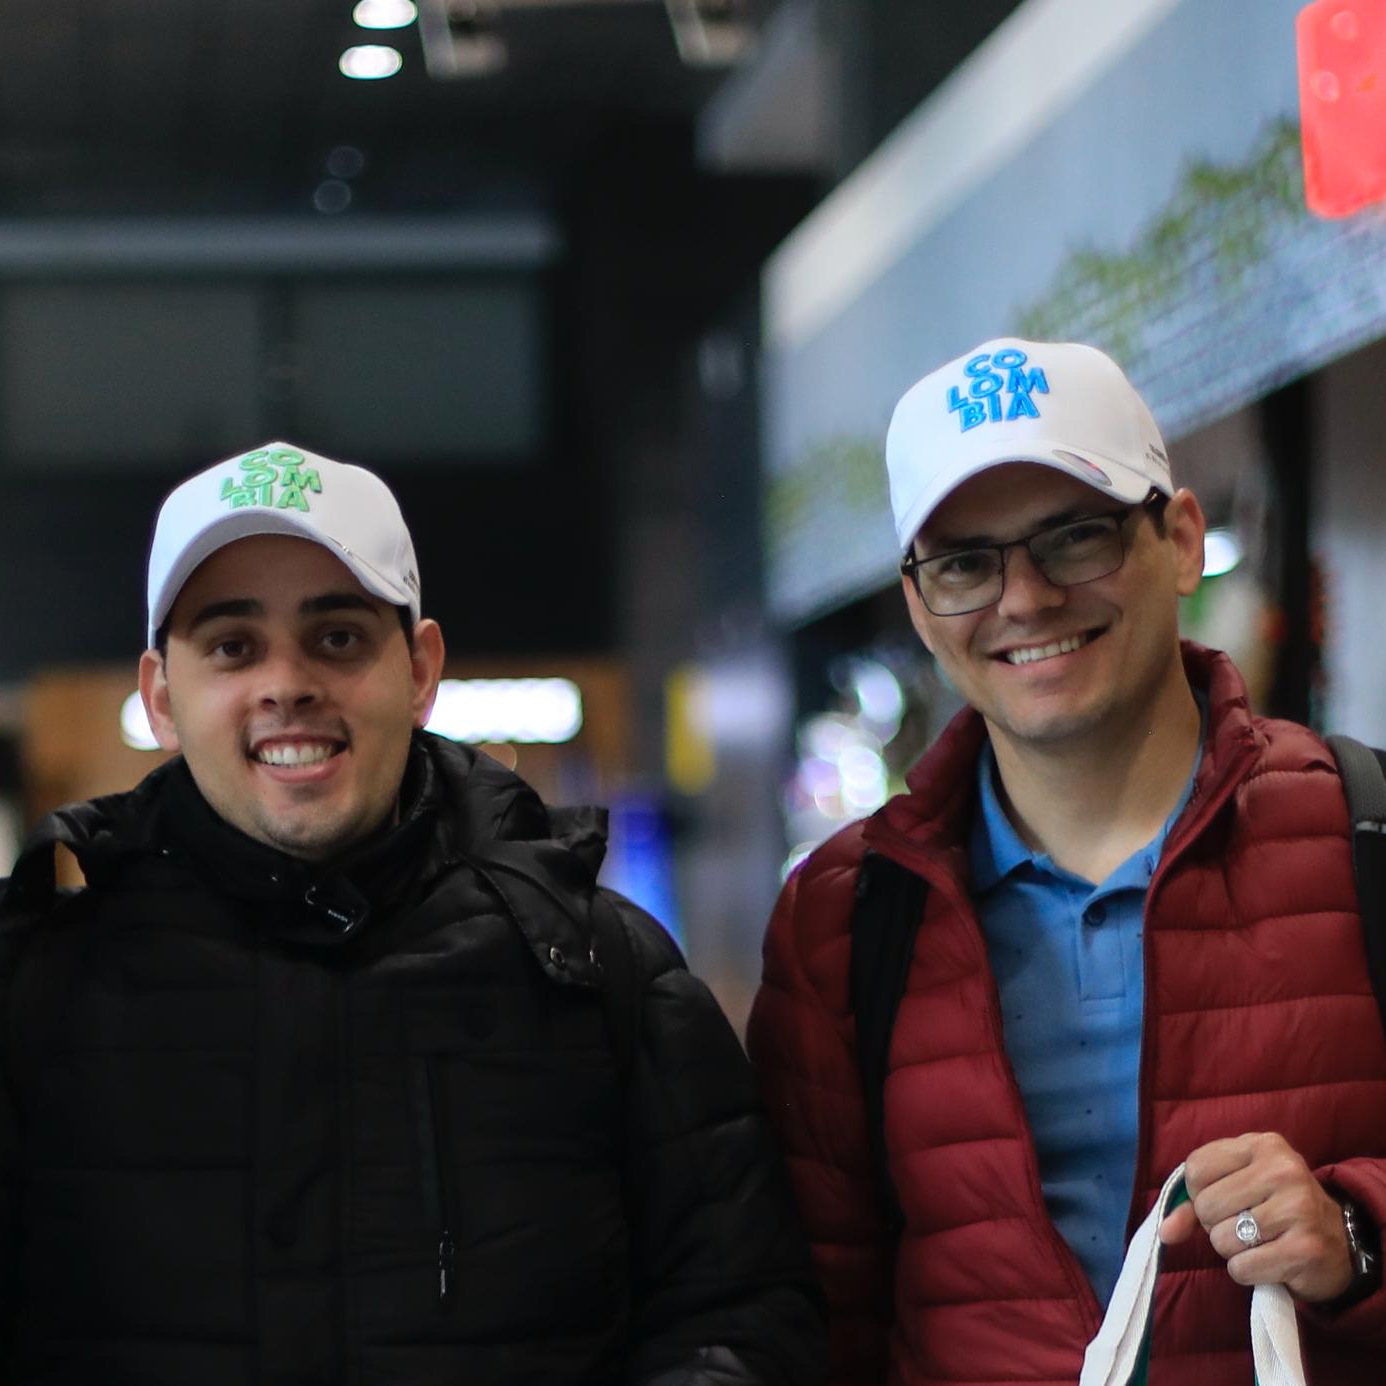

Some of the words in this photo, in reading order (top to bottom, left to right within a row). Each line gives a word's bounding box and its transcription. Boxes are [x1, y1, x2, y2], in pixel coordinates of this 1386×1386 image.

[964, 348, 1027, 378] CO
[947, 367, 1050, 413] LOM
[959, 391, 1040, 433] BIA
[239, 449, 305, 470] CO
[220, 465, 322, 500] LOM
[229, 484, 310, 512] BIA
